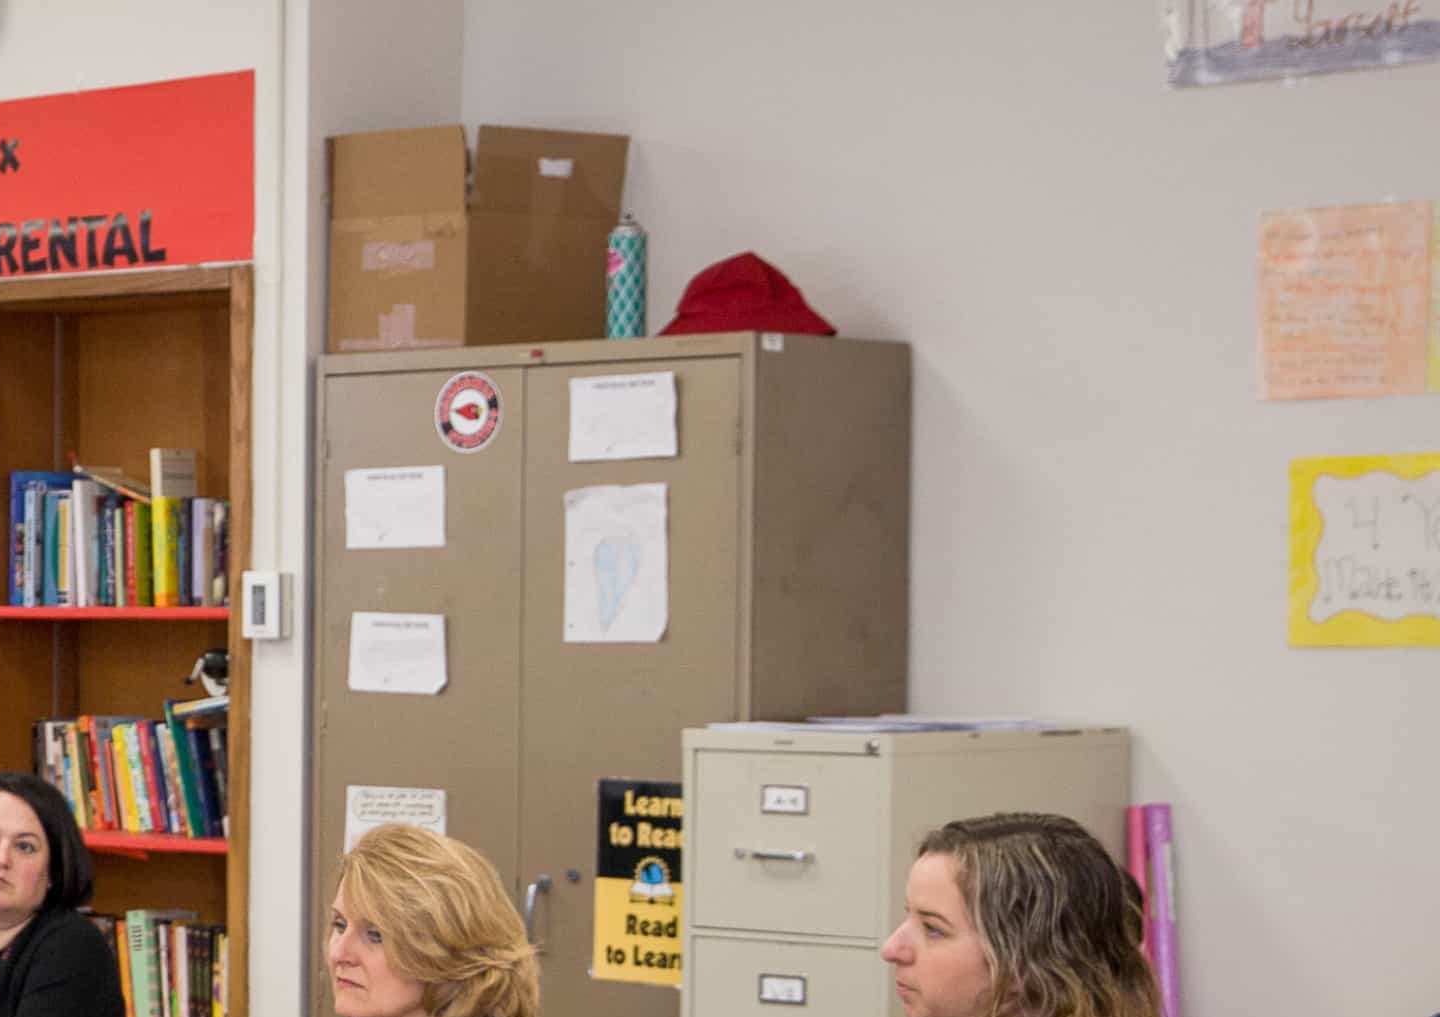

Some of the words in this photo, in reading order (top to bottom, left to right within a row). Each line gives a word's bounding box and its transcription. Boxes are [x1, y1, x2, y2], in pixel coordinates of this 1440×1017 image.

[609, 821, 633, 847] to
[625, 913, 678, 938] Read
[606, 945, 626, 966] to
